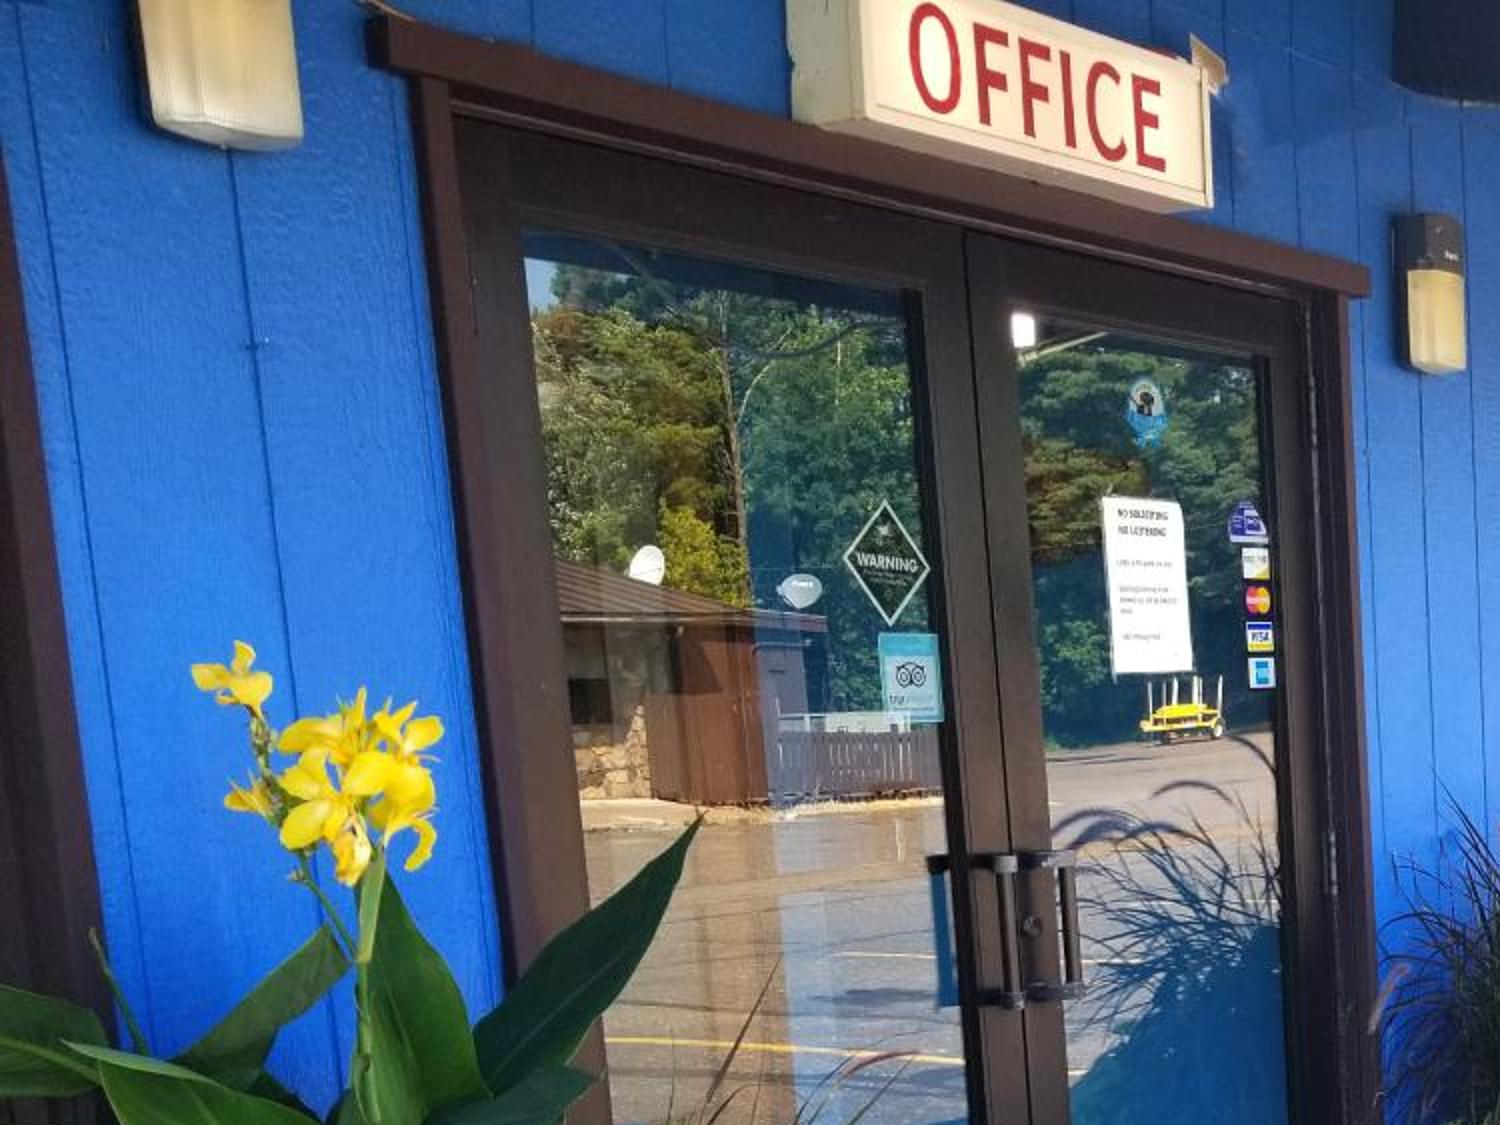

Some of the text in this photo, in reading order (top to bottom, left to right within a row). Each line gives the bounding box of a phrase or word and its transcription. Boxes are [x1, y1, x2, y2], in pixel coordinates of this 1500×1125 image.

[908, 2, 1167, 174] OFFICE
[855, 551, 919, 574] WARNING
[1251, 631, 1270, 642] VISA
